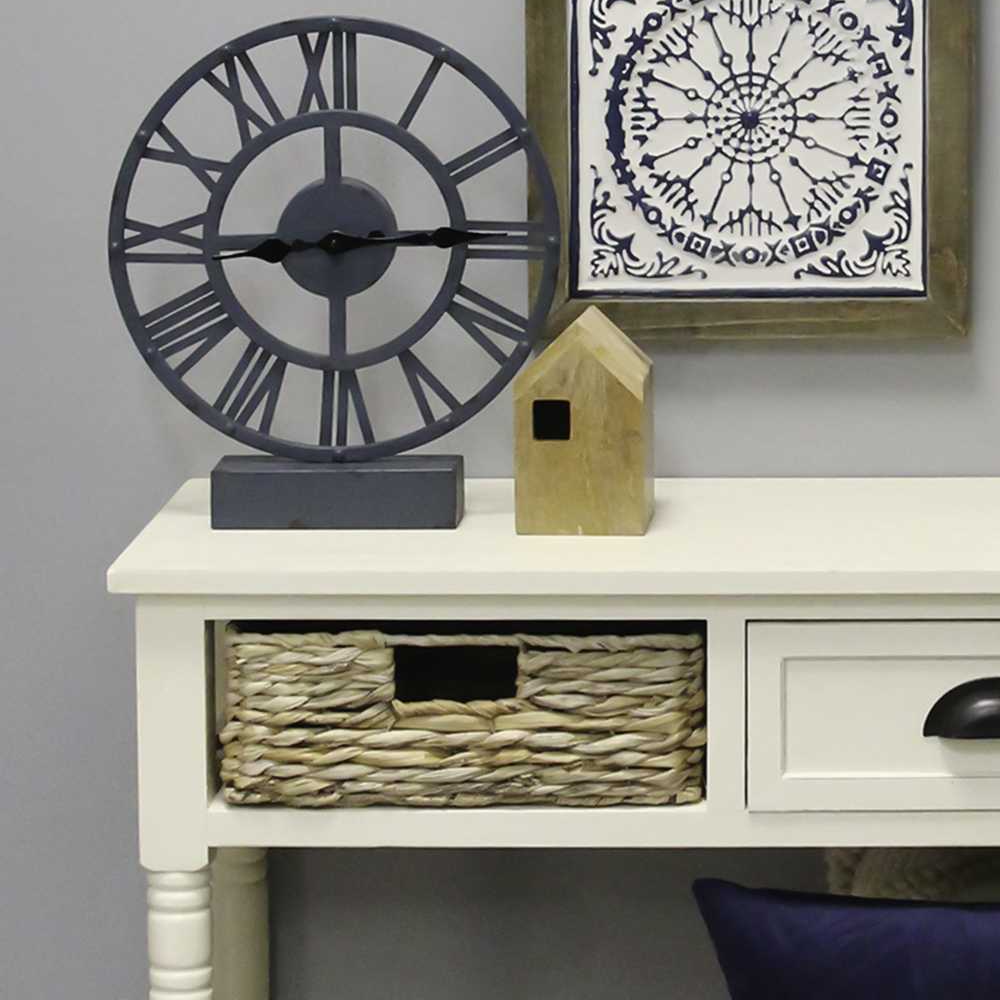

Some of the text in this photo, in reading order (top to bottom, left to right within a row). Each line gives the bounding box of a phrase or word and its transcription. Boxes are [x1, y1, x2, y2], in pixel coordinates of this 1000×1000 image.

[202, 51, 287, 149] XI
[296, 31, 358, 115] XII
[140, 120, 232, 193] X
[443, 126, 526, 186] II
